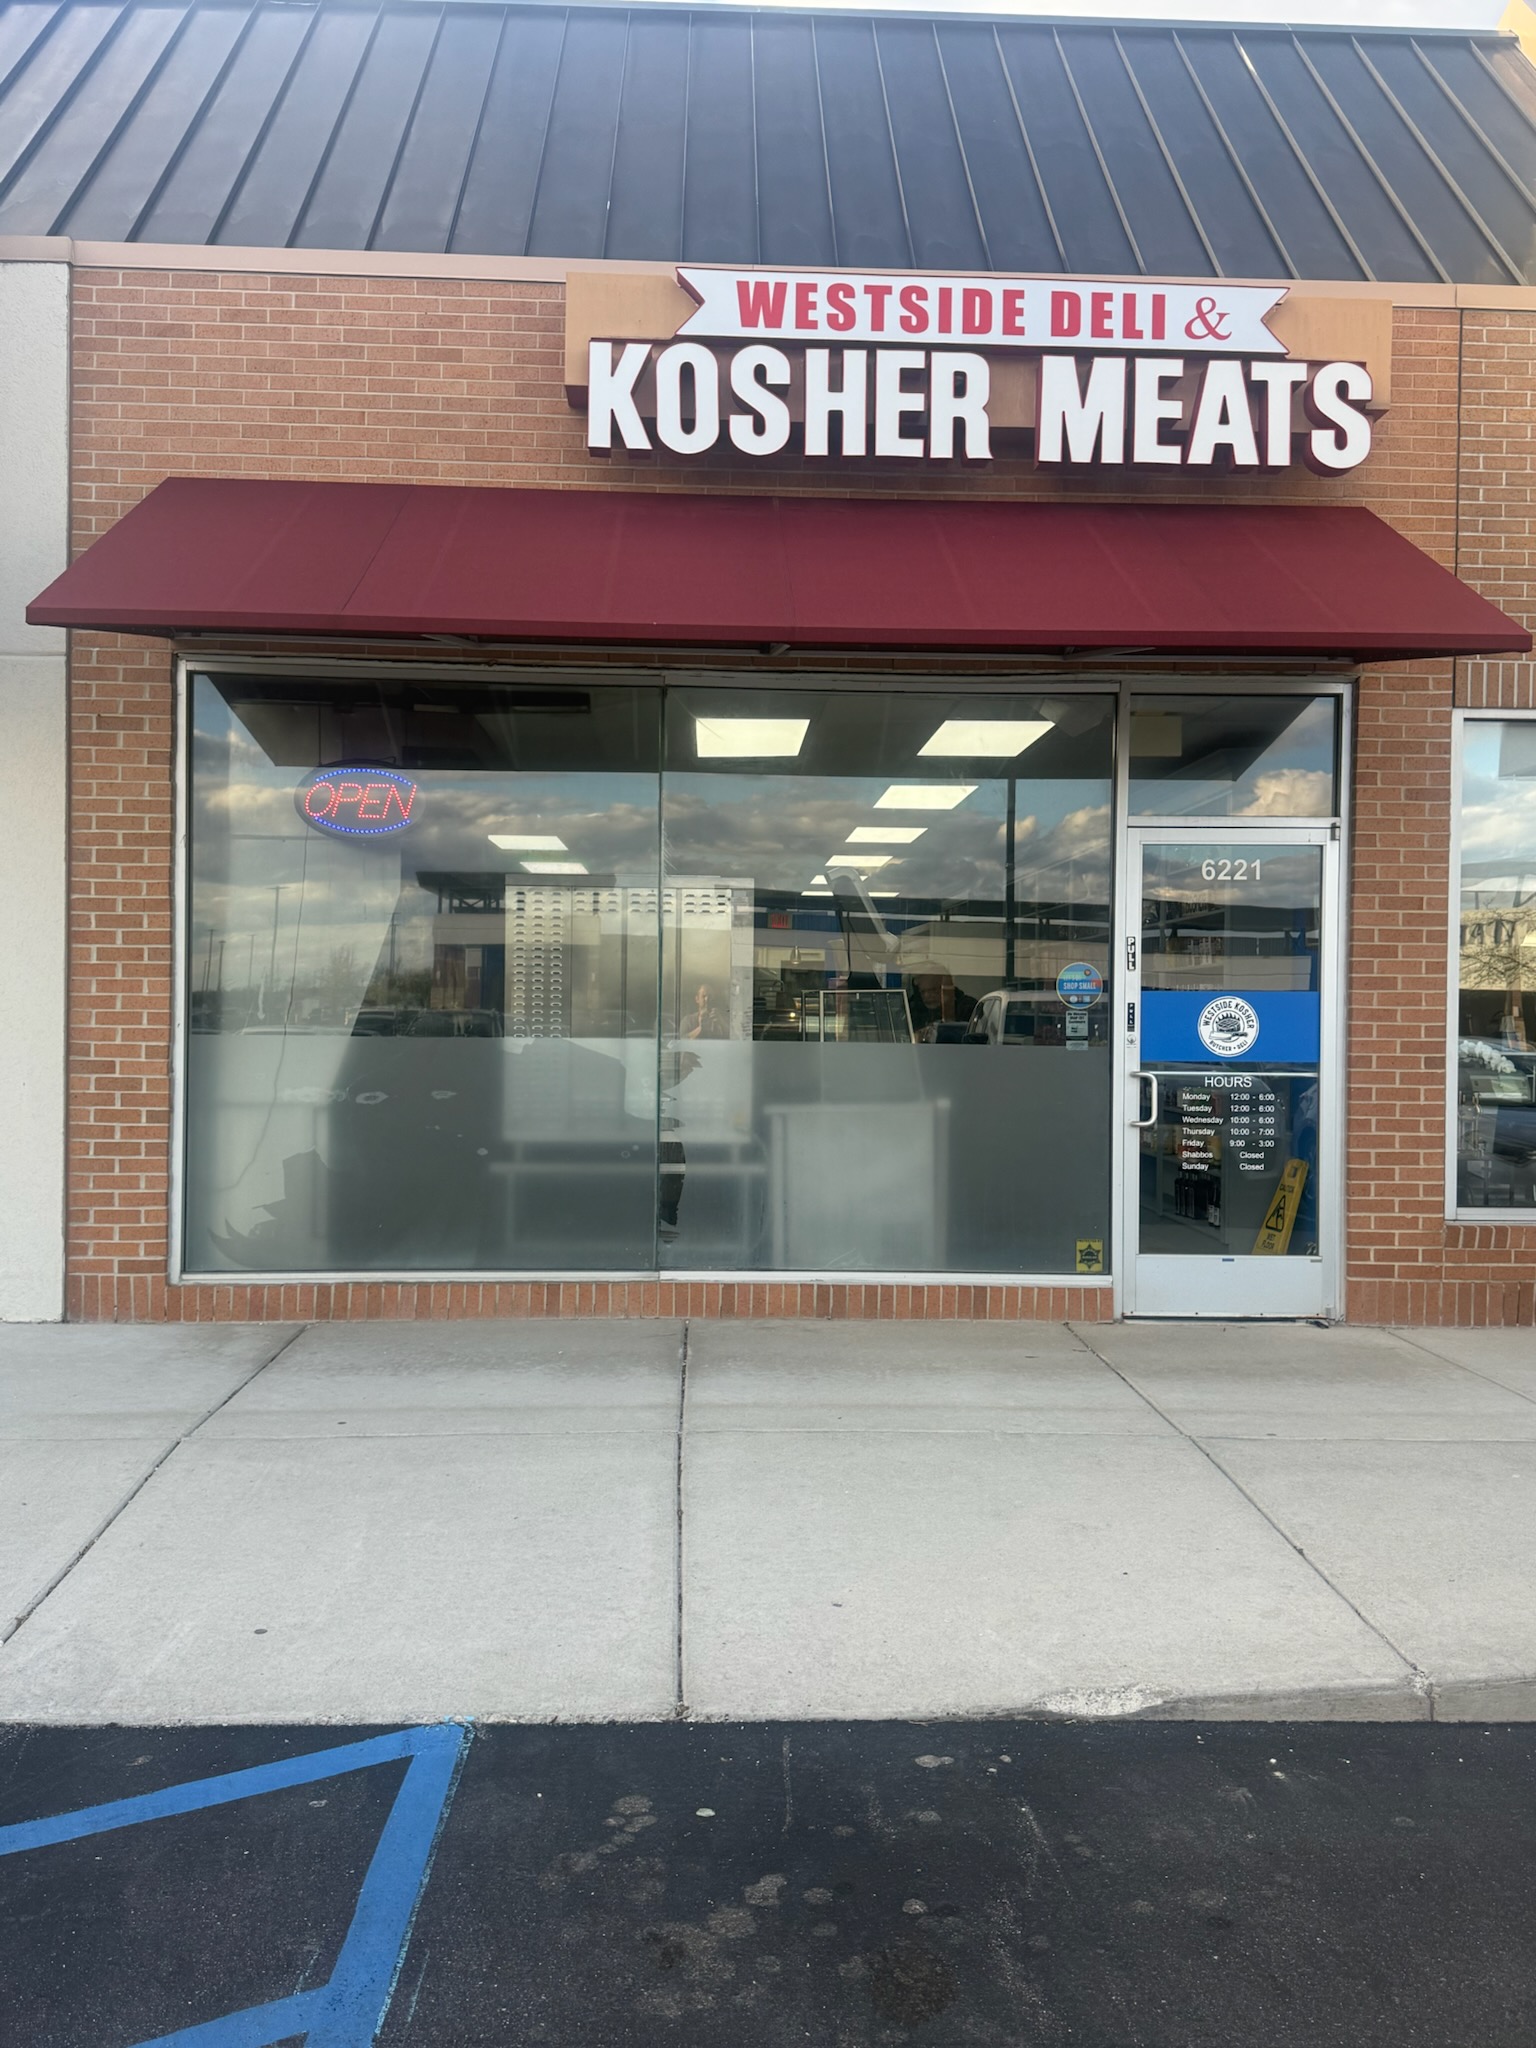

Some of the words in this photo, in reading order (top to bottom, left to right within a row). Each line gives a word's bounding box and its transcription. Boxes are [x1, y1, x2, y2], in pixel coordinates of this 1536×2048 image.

[735, 279, 1026, 338] WESTSIDE
[1051, 291, 1167, 340] DELI
[1183, 297, 1233, 341] &
[587, 341, 993, 460] KOSHER
[1038, 355, 1373, 470] MEATS
[304, 781, 418, 819] OPEN
[1201, 858, 1261, 881] 6221
[1127, 937, 1136, 970] PULL
[1063, 982, 1078, 990] SHOP
[1079, 982, 1096, 990] SMALL
[1202, 1001, 1232, 1026] WESTSIDE
[1234, 1003, 1254, 1029] KOSHER
[1209, 1040, 1232, 1052] BUTCHER
[1236, 1040, 1248, 1051] DELI
[1204, 1076, 1252, 1088] HOURS
[1182, 1093, 1211, 1101] Monday
[1182, 1105, 1212, 1113] Tuesday
[1182, 1117, 1224, 1125] Wednesday
[1182, 1128, 1215, 1136] Thursday
[1182, 1140, 1205, 1148] Friday
[1239, 1151, 1264, 1159] Closed
[1182, 1163, 1209, 1171] Sunday
